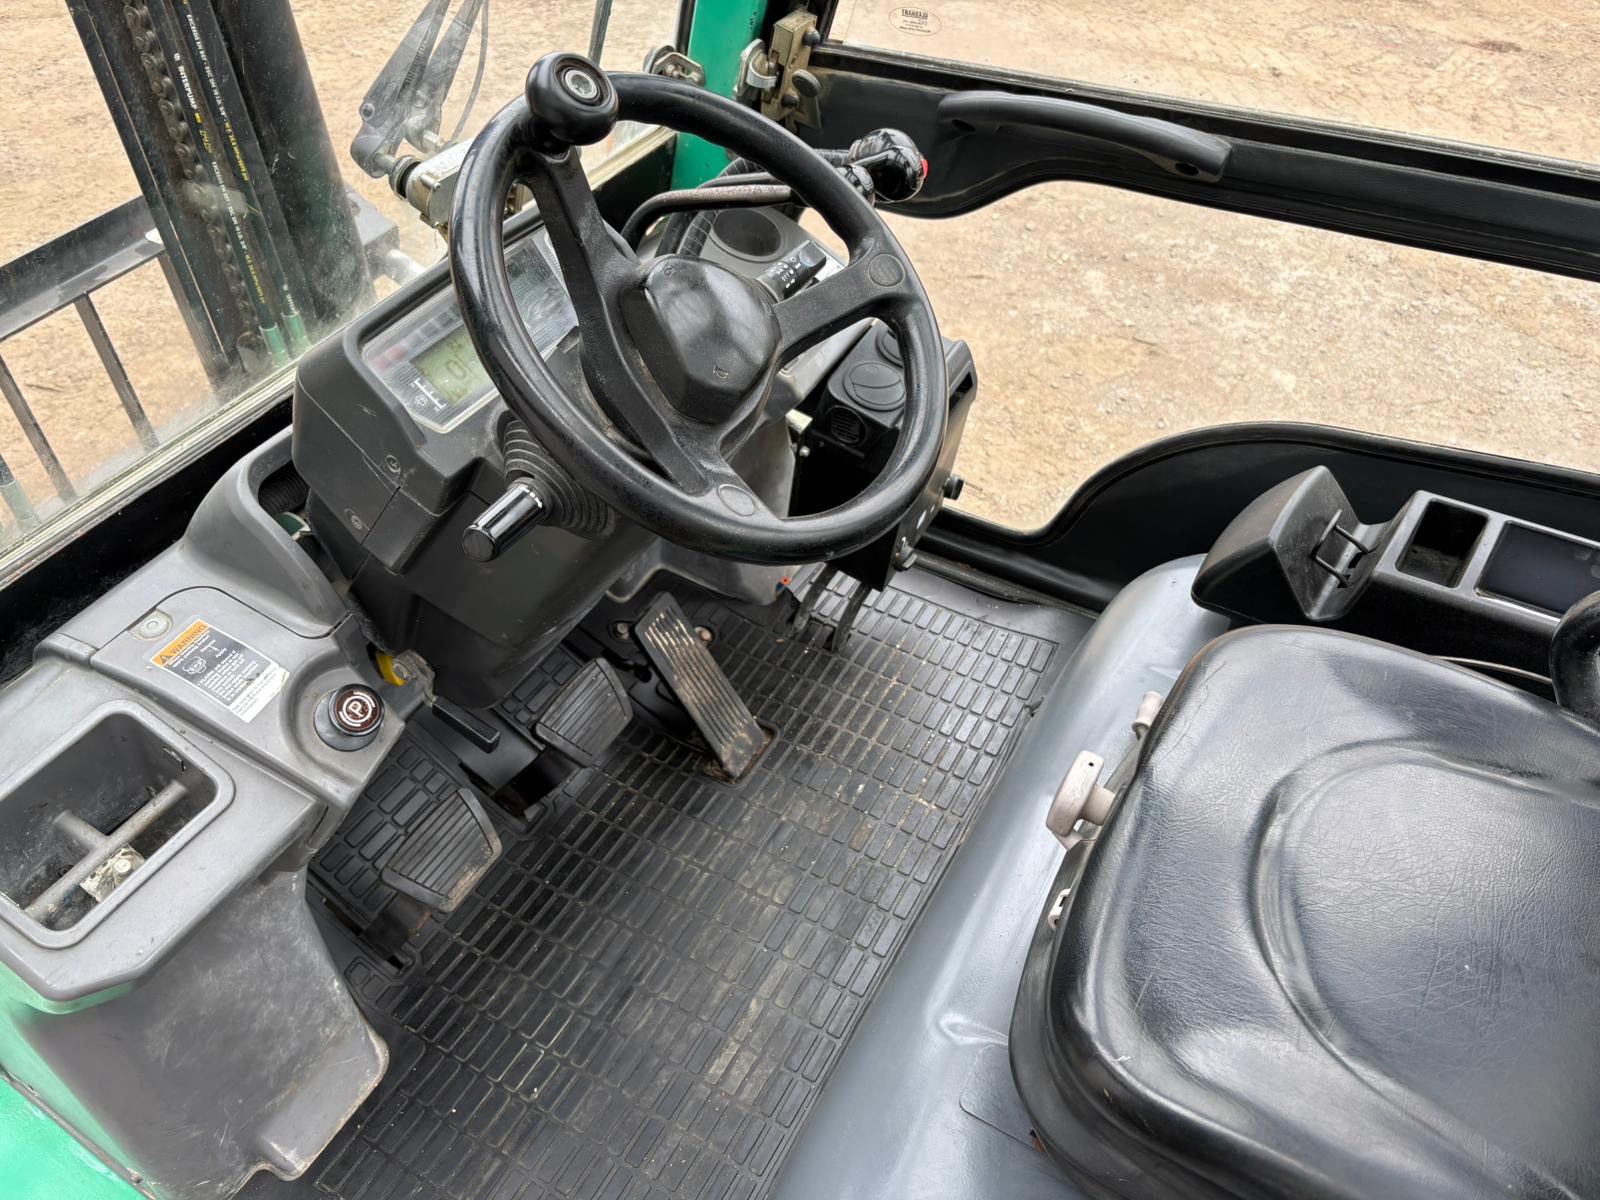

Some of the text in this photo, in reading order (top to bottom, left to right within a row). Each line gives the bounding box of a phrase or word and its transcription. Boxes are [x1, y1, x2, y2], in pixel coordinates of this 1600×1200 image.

[177, 65, 198, 110] INTERPUMP
[170, 623, 208, 654] WARNING
[347, 701, 364, 718] P
